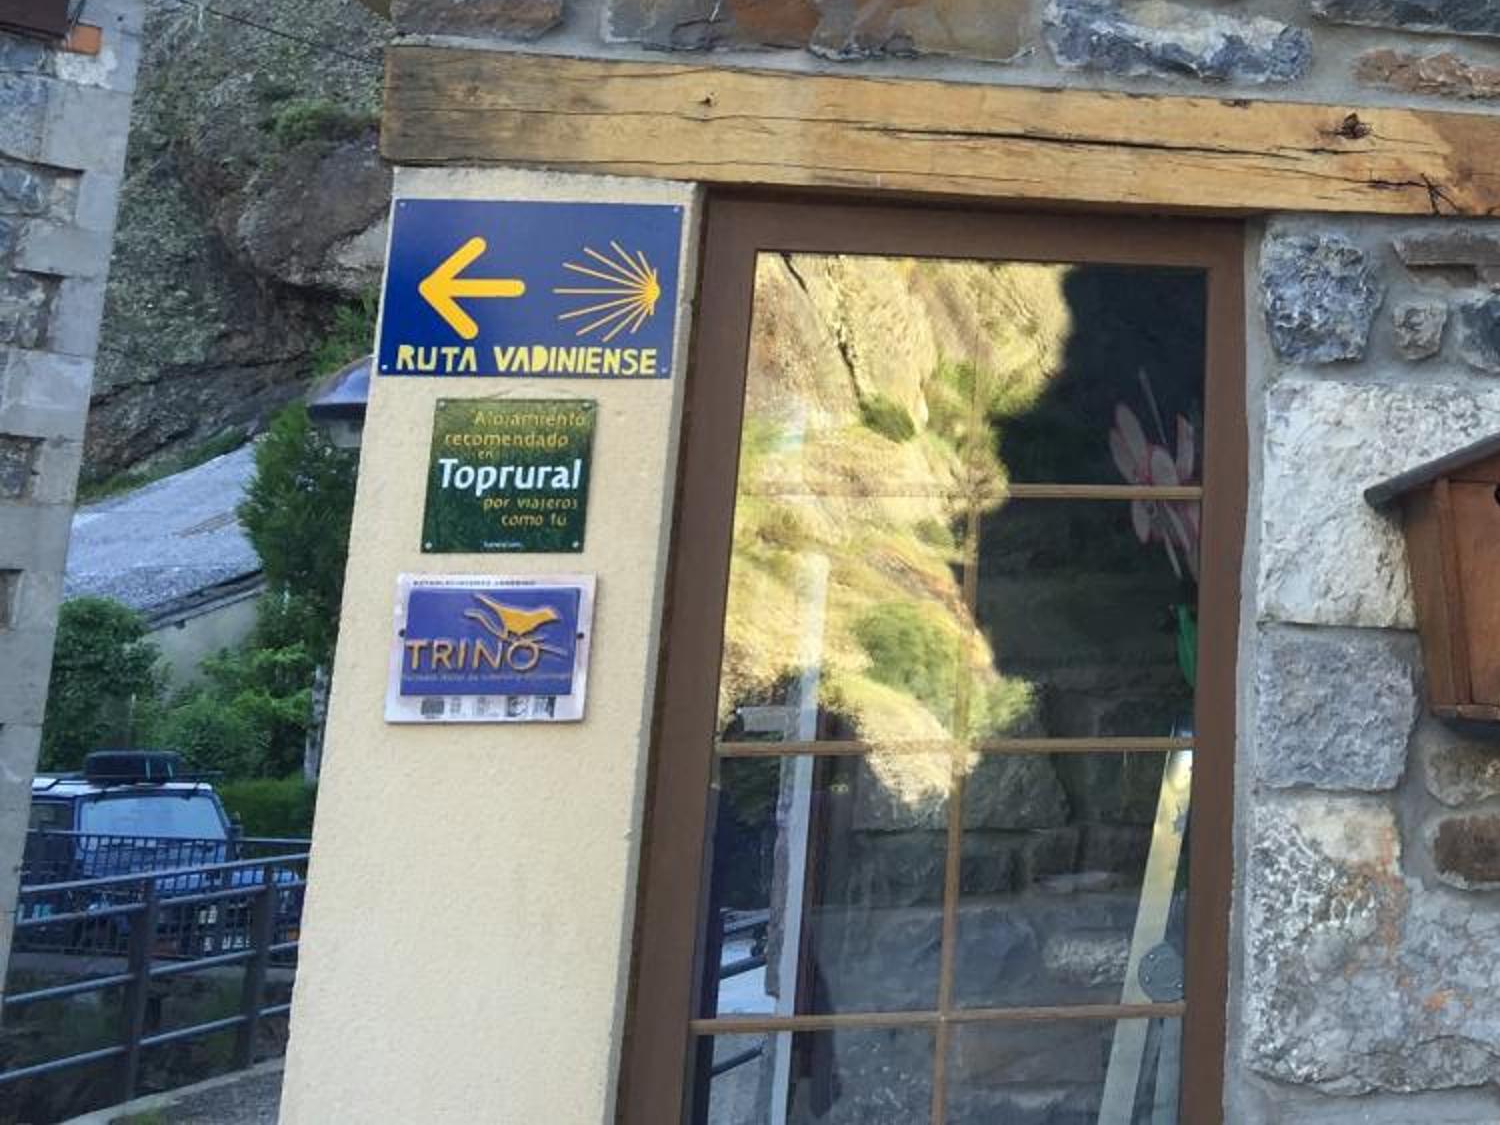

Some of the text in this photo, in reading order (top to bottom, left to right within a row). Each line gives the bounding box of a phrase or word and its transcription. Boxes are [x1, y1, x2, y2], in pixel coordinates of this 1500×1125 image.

[396, 345, 657, 375] RUTA VADINIENSE
[445, 431, 569, 447] recomendado
[438, 458, 582, 497] Toprural
[483, 497, 511, 510] por
[501, 513, 544, 526] como
[404, 637, 540, 671] TRINO
